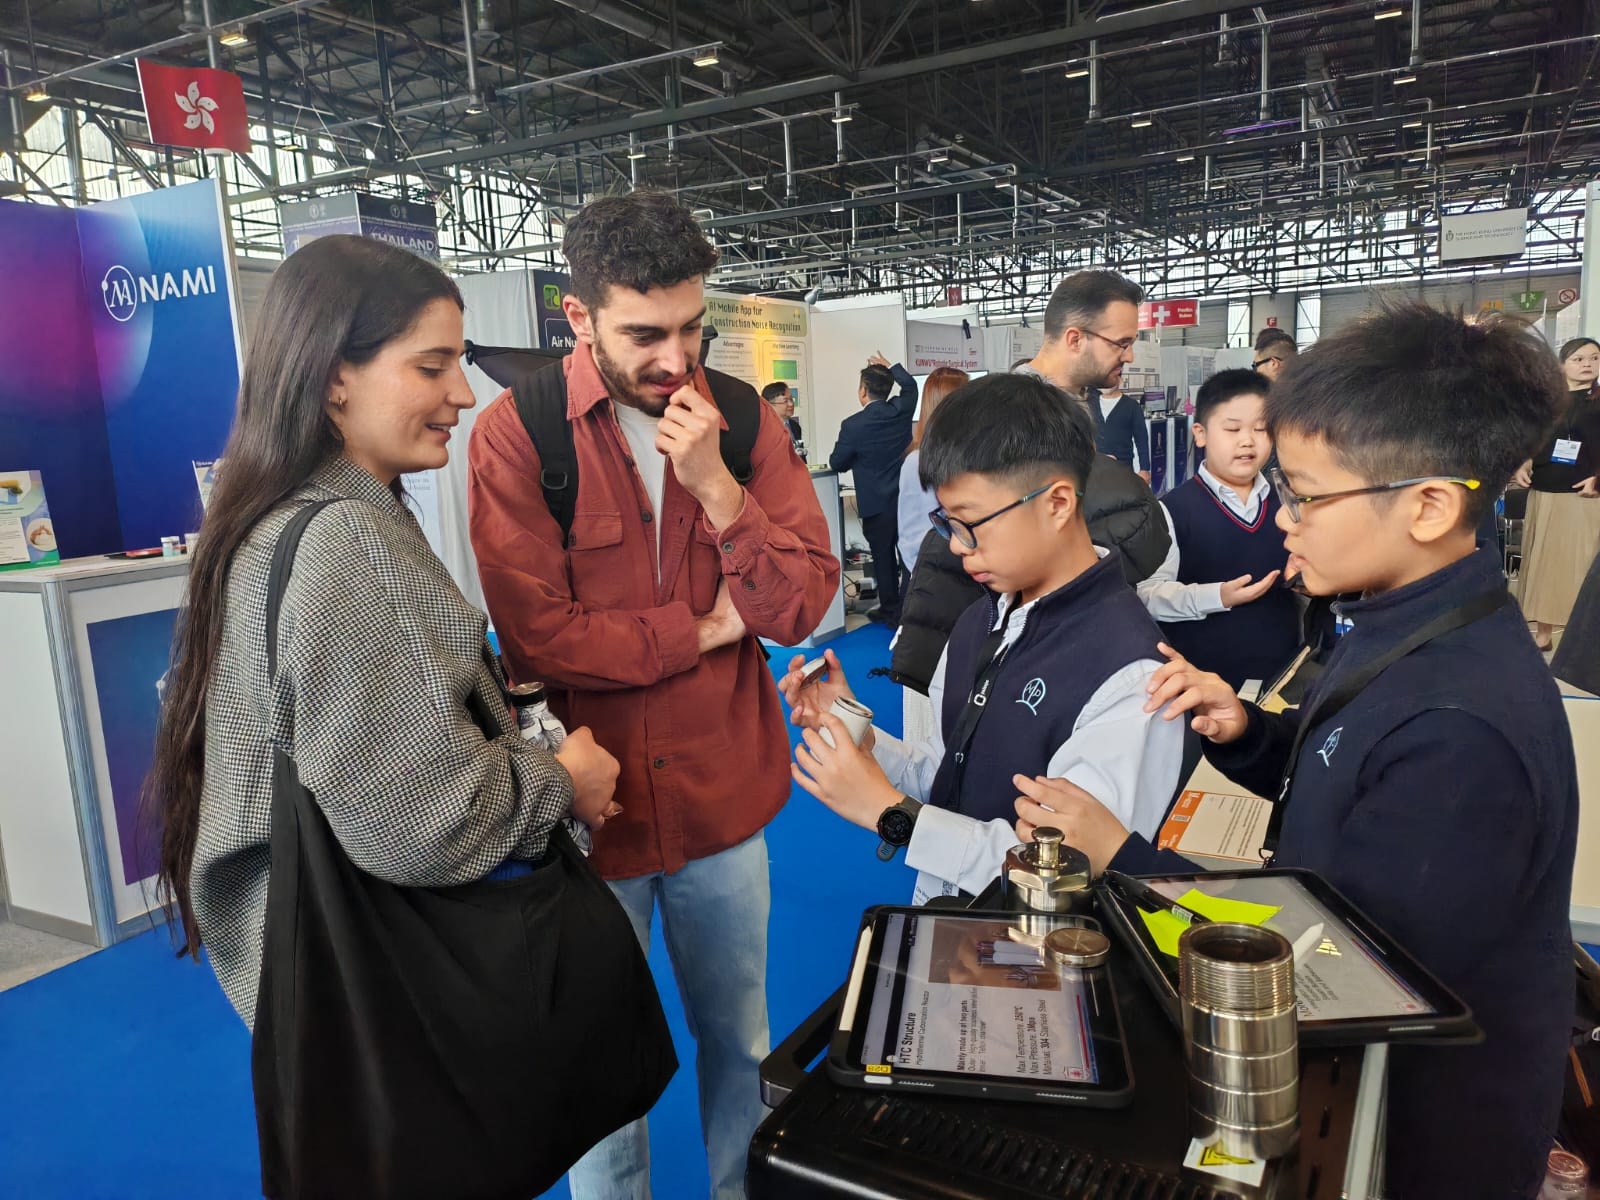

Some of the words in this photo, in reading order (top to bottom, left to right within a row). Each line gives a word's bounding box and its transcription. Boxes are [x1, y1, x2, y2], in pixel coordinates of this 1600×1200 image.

[371, 232, 435, 251] THAILAND
[139, 265, 216, 303] NAMI
[718, 303, 739, 314] Mobile
[740, 304, 752, 316] App
[551, 335, 564, 348] Air
[564, 336, 577, 348] Nu
[901, 1012, 916, 1045] Structure
[959, 1037, 967, 1052] made
[1040, 1038, 1050, 1049] 304
[899, 1047, 912, 1064] HTC
[956, 1053, 967, 1071] Mainly
